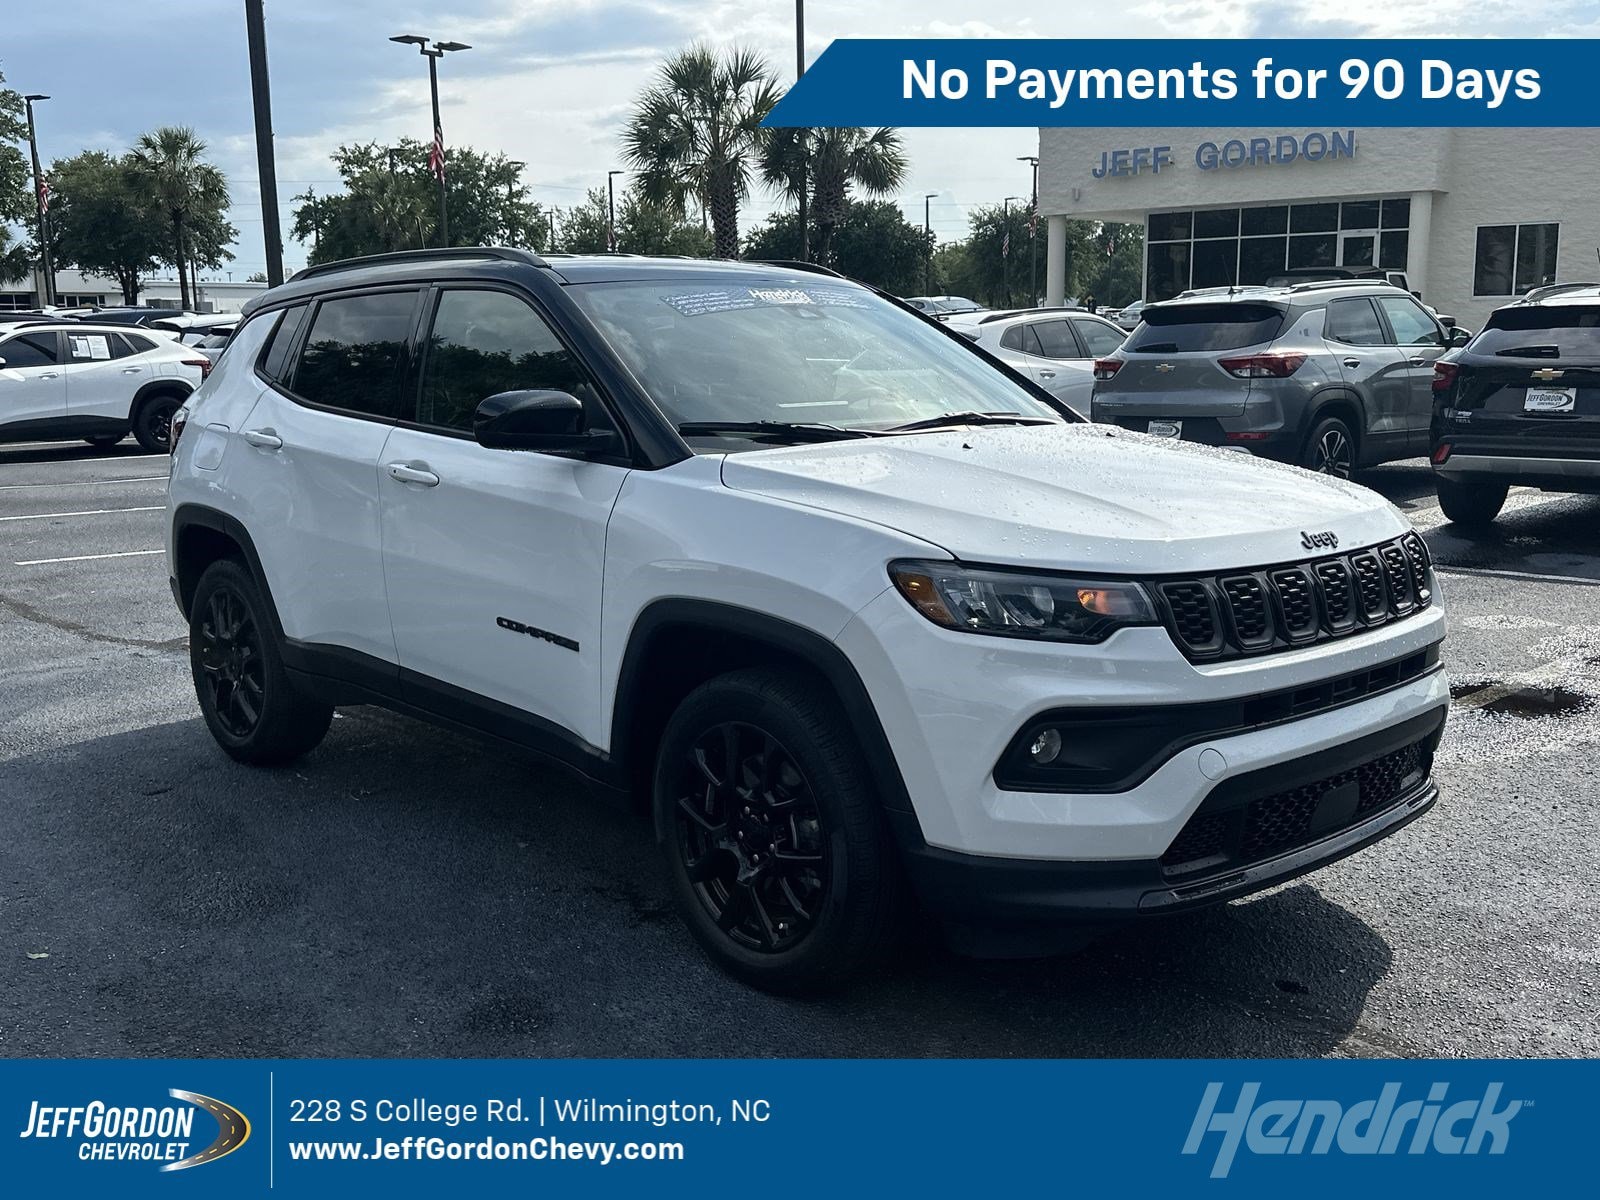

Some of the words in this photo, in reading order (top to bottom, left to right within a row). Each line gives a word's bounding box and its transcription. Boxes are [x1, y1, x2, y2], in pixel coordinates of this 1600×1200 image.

[1092, 146, 1171, 179] JEFF
[1195, 130, 1355, 171] GORDON
[1300, 530, 1339, 550] Jeep
